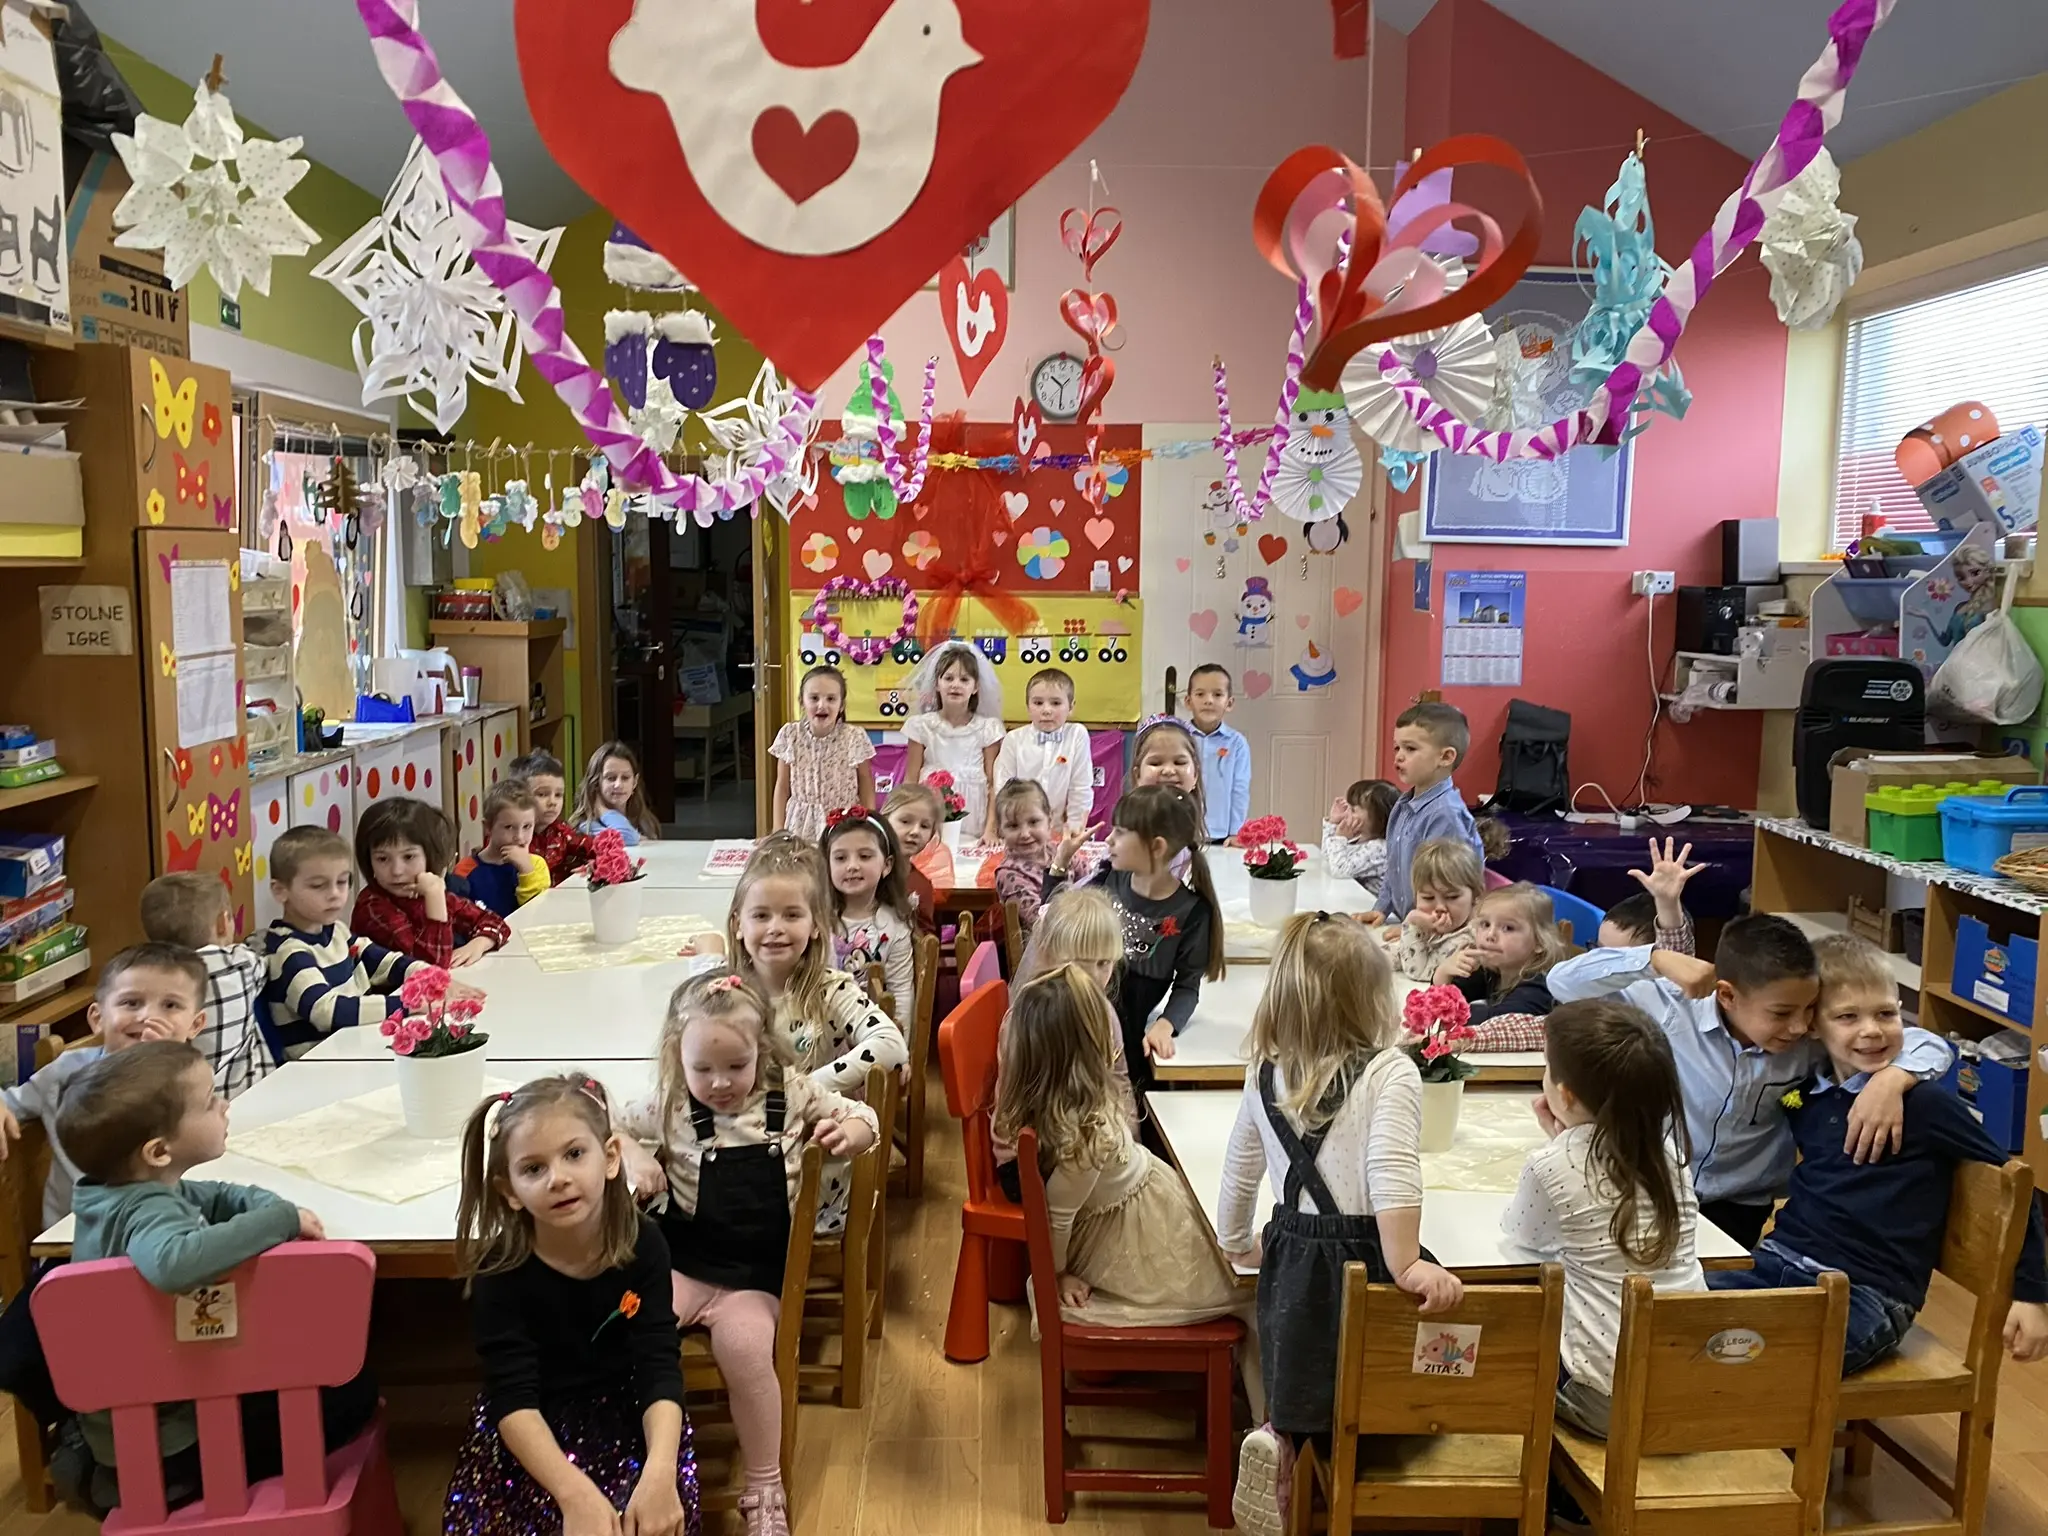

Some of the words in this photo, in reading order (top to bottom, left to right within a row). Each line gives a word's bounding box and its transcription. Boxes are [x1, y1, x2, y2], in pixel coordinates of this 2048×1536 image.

[1042, 371, 1050, 381] 10
[1041, 391, 1047, 401] 8
[1997, 505, 2015, 530] 5
[51, 605, 124, 621] STOLNE
[66, 630, 111, 646] IGRE
[863, 639, 870, 651] 1
[904, 639, 912, 651] 2
[984, 638, 993, 651] 4
[1031, 638, 1039, 650] 5
[1069, 638, 1078, 649] 6
[1109, 637, 1117, 649] 7
[889, 691, 899, 704] 8
[195, 1324, 225, 1337] KIM
[1423, 1363, 1451, 1375] ZITA
